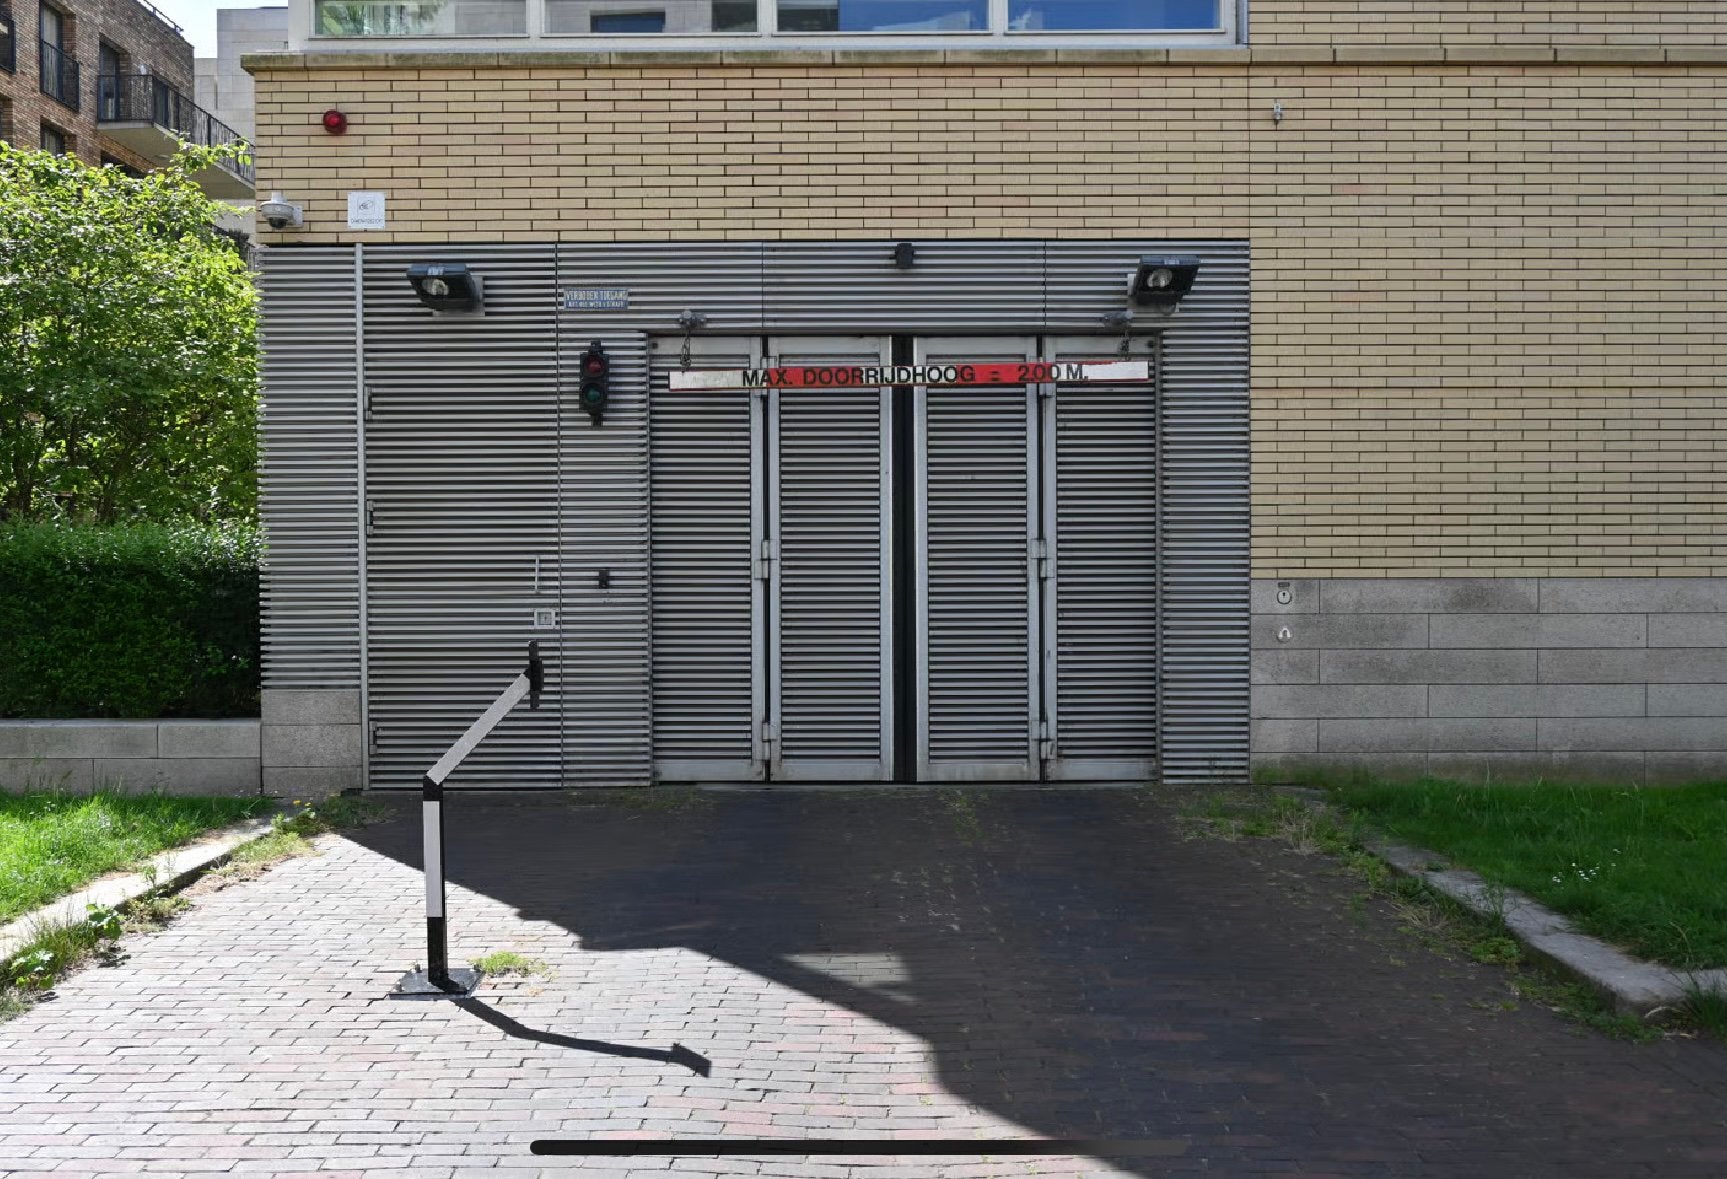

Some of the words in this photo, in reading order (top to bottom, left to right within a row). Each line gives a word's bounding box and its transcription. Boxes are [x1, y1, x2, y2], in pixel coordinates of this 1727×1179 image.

[742, 369, 793, 387] MAX.
[803, 365, 976, 385] DOORRIJDHOOG
[1066, 363, 1089, 380] M.
